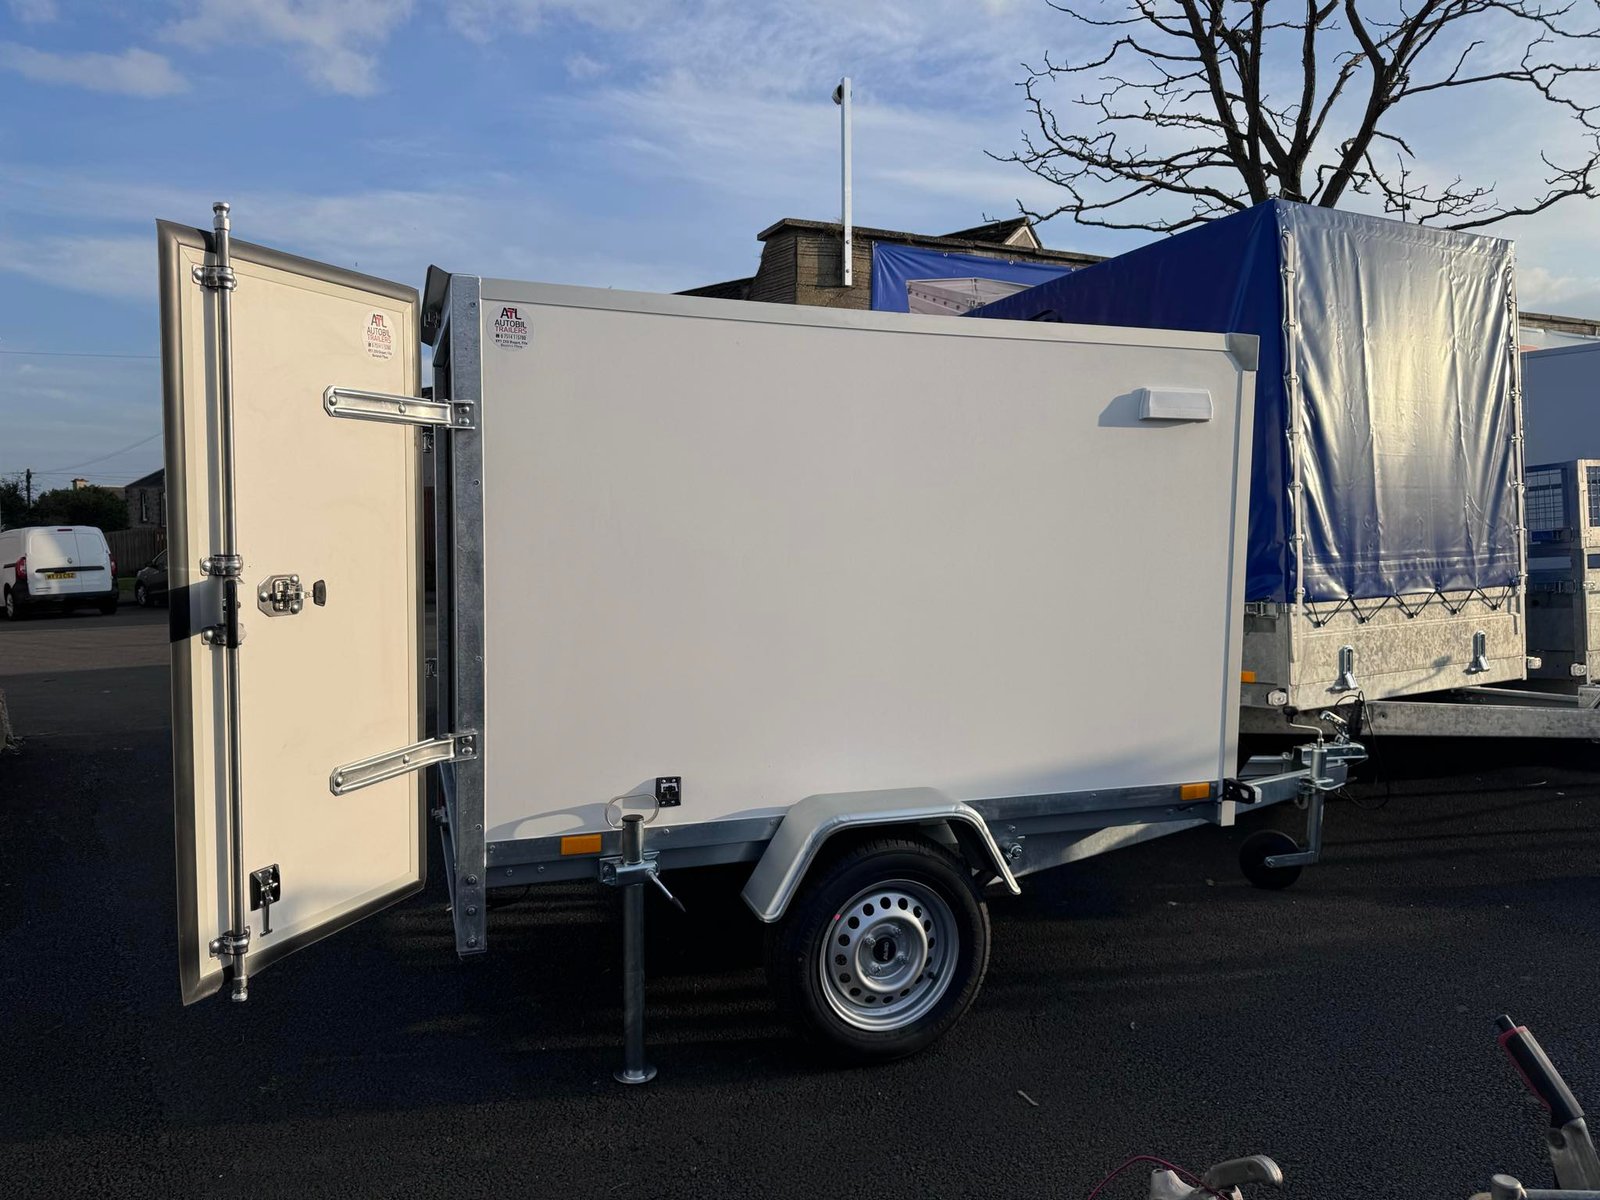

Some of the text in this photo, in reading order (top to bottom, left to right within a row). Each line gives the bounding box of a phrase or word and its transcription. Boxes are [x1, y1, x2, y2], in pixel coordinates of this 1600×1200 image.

[501, 307, 522, 320] ATL
[371, 313, 387, 328] ATL
[494, 319, 527, 328] AUTOBIL
[495, 326, 527, 334] TRAILERS
